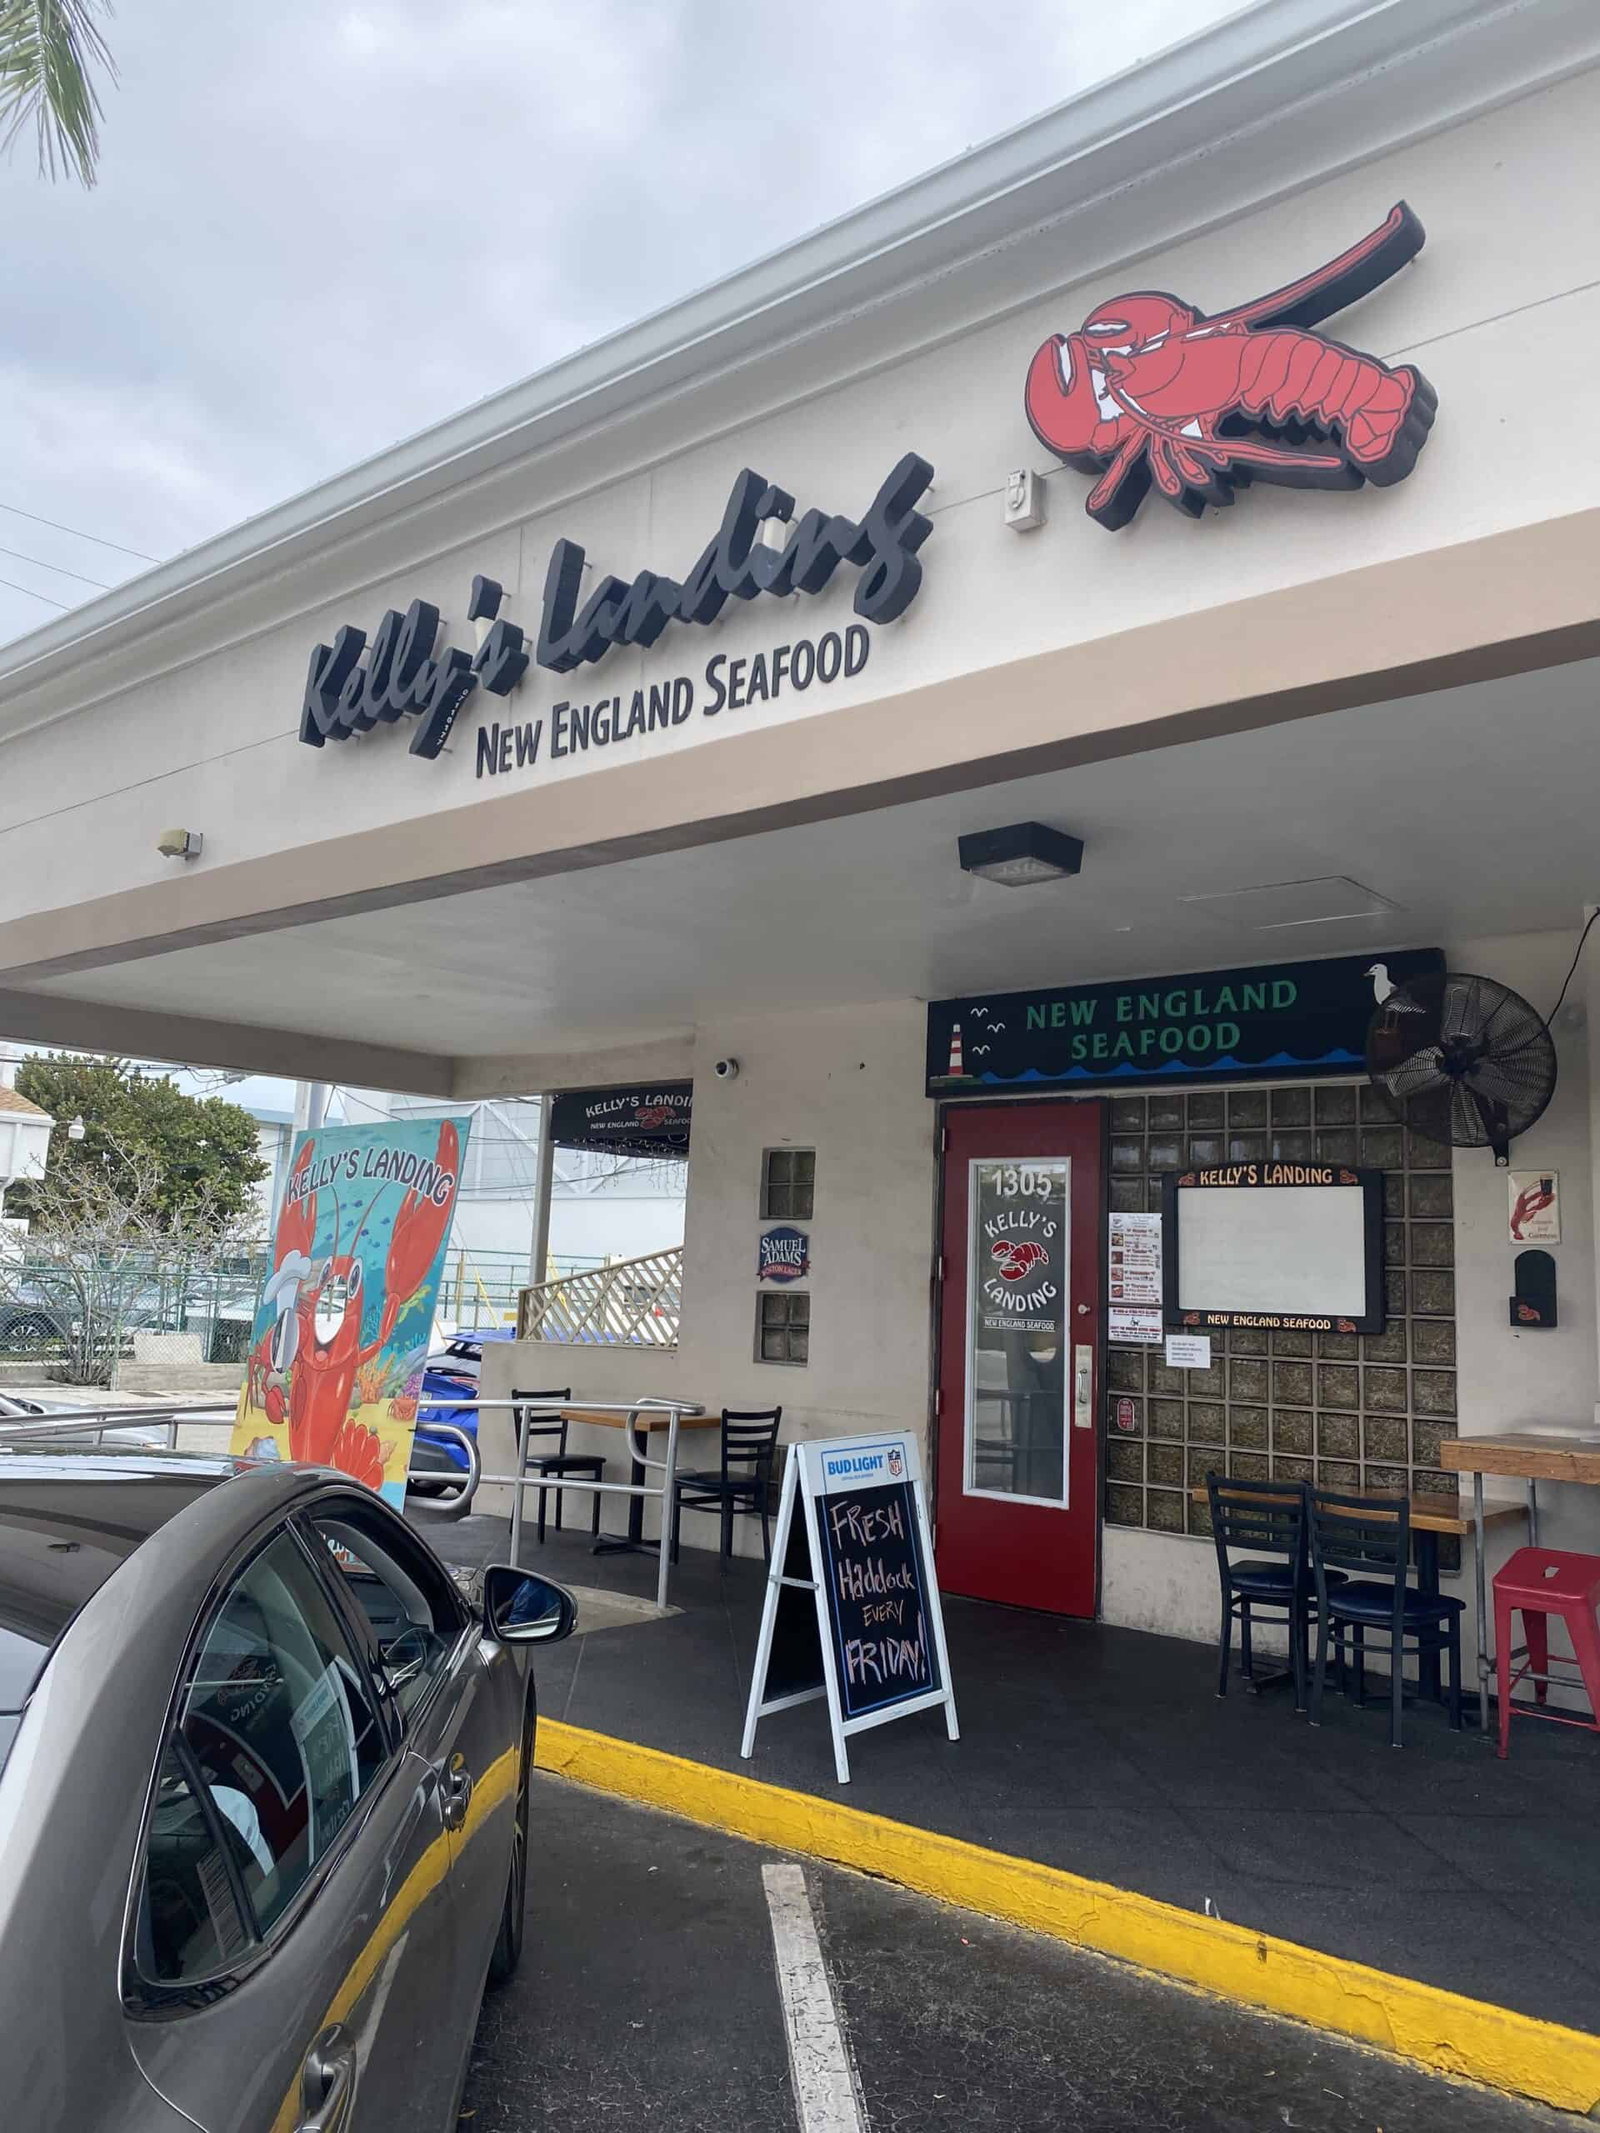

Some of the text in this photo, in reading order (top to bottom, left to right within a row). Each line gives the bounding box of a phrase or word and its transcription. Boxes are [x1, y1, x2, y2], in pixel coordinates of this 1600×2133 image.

[299, 451, 934, 761] Kelly's Landing
[1026, 979, 1298, 1030] NEW ENGLAND
[1071, 1022, 1241, 1060] SEAFOOD
[585, 1096, 640, 1119] KELLY'S
[288, 1148, 455, 1206] KELLY'S LANDING
[991, 1169, 1052, 1196] 1305
[1200, 1163, 1333, 1185] KELLY'S LANDING
[984, 1210, 1057, 1239] KELLY'S
[761, 1237, 806, 1253] SAMUEL
[763, 1251, 802, 1267] ADAMS
[983, 1268, 1057, 1313] LANDING
[1207, 1314, 1331, 1330] NEW ENGLAND SEAFOOD
[827, 1460, 852, 1475] BUD
[853, 1455, 883, 1472] LIGHT
[830, 1500, 905, 1549] FRESH
[862, 1599, 904, 1628] EVERY
